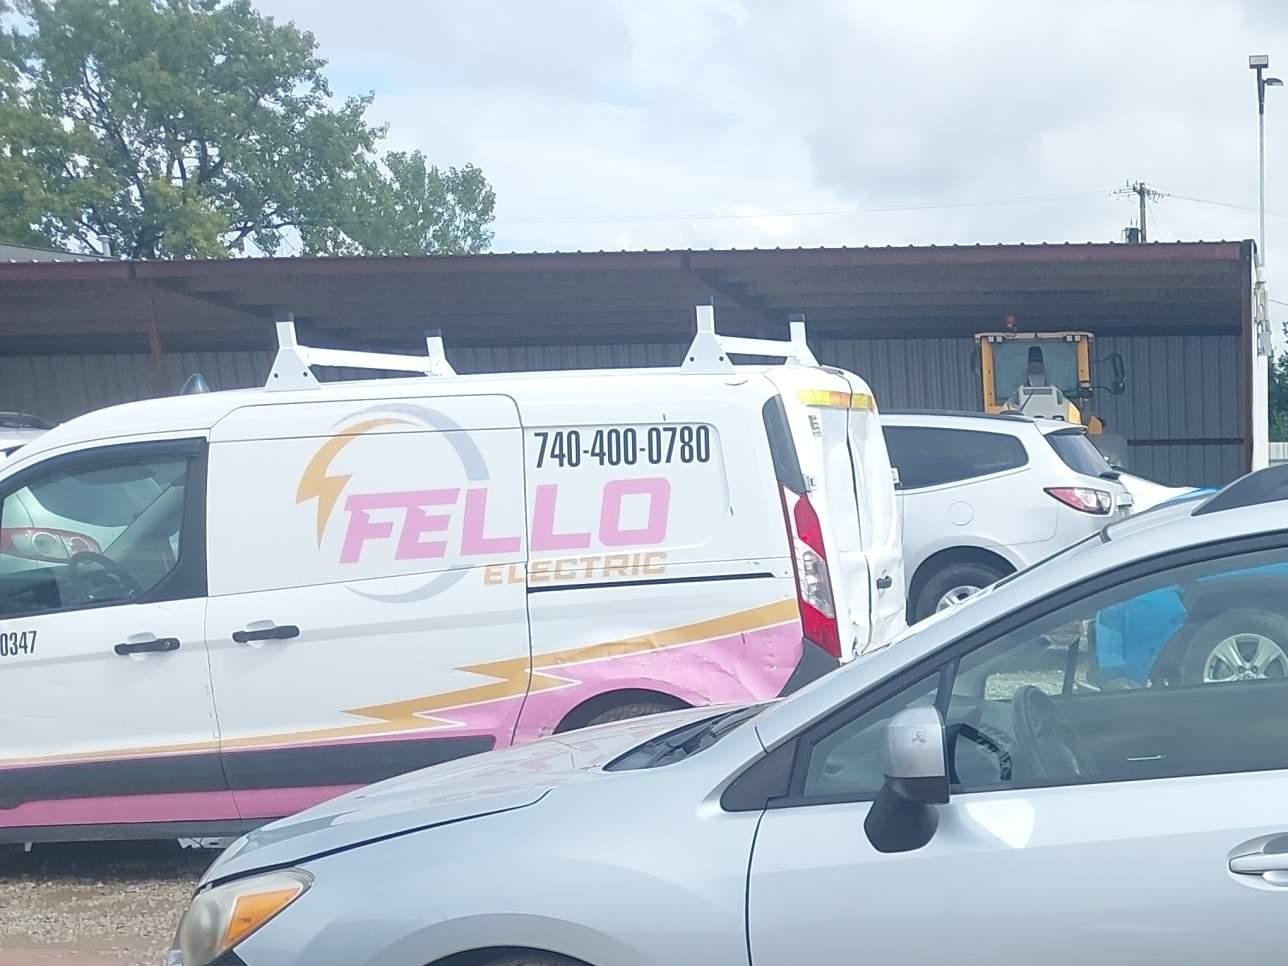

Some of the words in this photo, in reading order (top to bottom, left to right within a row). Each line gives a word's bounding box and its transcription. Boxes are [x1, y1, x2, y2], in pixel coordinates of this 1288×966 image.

[533, 425, 711, 469] 740-400-0780
[339, 476, 672, 564] FELLO
[482, 551, 668, 586] ELECTRIC
[0, 630, 38, 657] 0347
